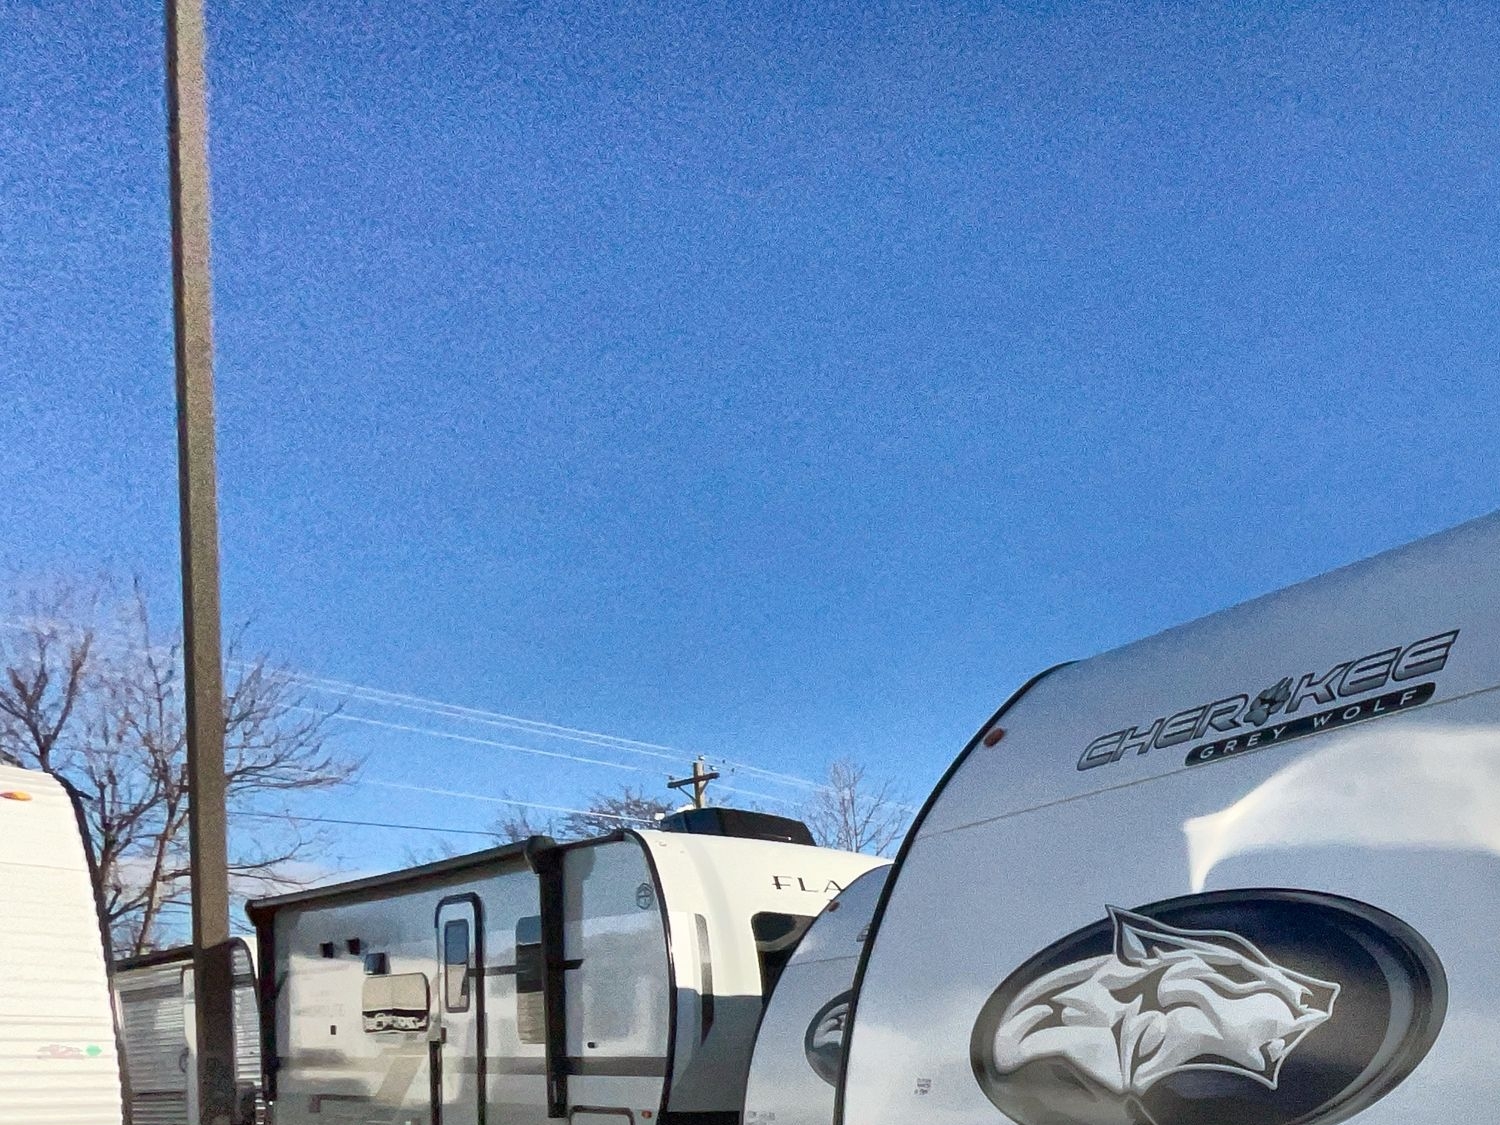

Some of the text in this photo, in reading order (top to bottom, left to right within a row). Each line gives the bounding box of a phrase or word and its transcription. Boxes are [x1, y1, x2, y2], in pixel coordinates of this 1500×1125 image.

[1200, 690, 1417, 759] GREY WOLF
[772, 875, 843, 893] FLA
